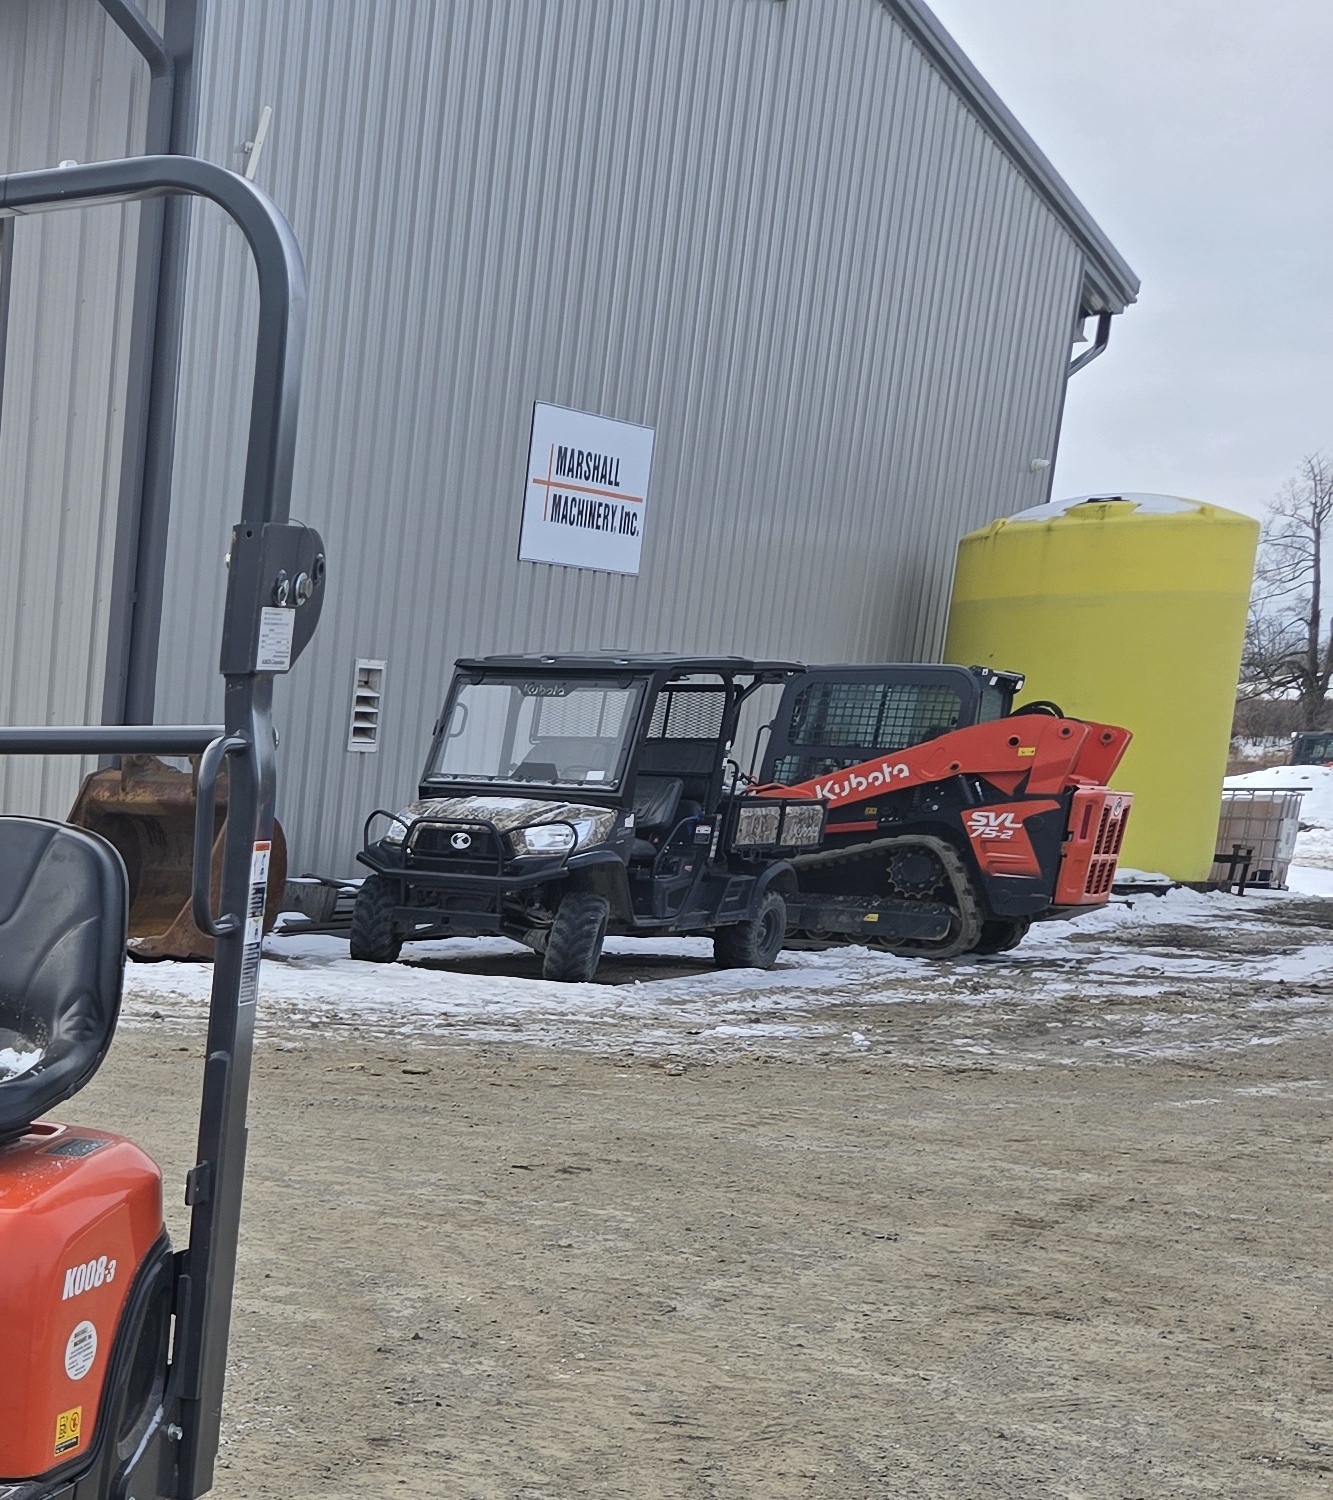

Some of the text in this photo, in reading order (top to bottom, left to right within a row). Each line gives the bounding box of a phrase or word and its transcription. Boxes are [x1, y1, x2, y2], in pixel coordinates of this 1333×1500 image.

[555, 445, 620, 487] MARSHALL
[550, 493, 640, 537] MACHINERY, Inc.
[523, 683, 565, 696] Kubota
[815, 763, 910, 799] Kubota
[967, 811, 1023, 828] SVL
[969, 826, 1014, 840] 75-2
[62, 1255, 117, 1301] K008-3
